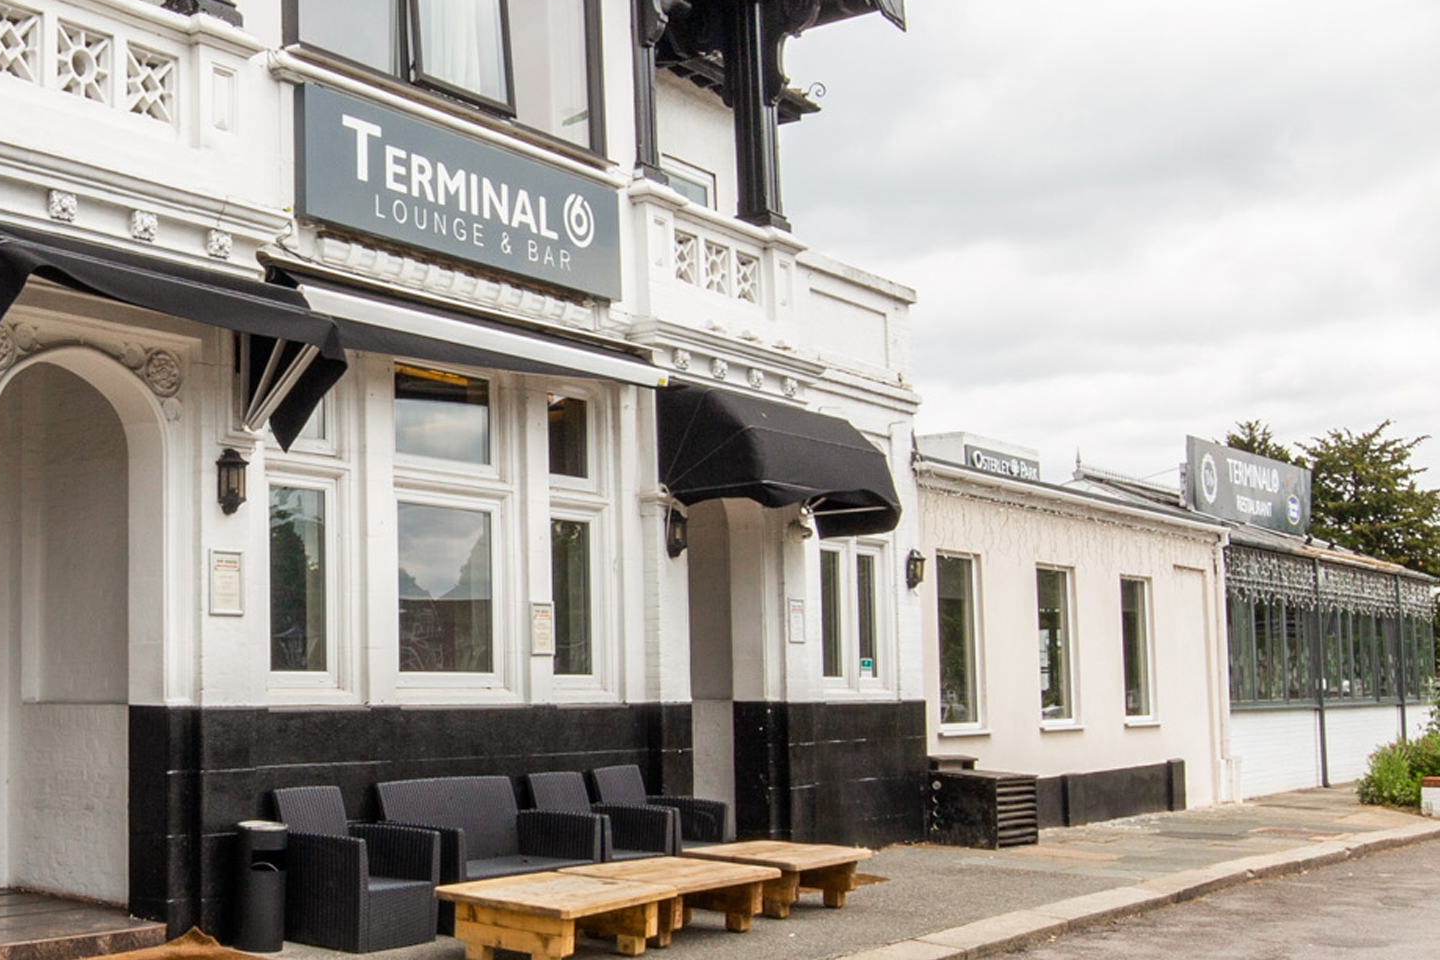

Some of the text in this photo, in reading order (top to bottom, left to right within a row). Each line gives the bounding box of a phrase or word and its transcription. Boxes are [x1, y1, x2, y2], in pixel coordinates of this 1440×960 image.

[342, 114, 559, 240] TERMINAL
[375, 194, 571, 271] LOUNGE & BAR
